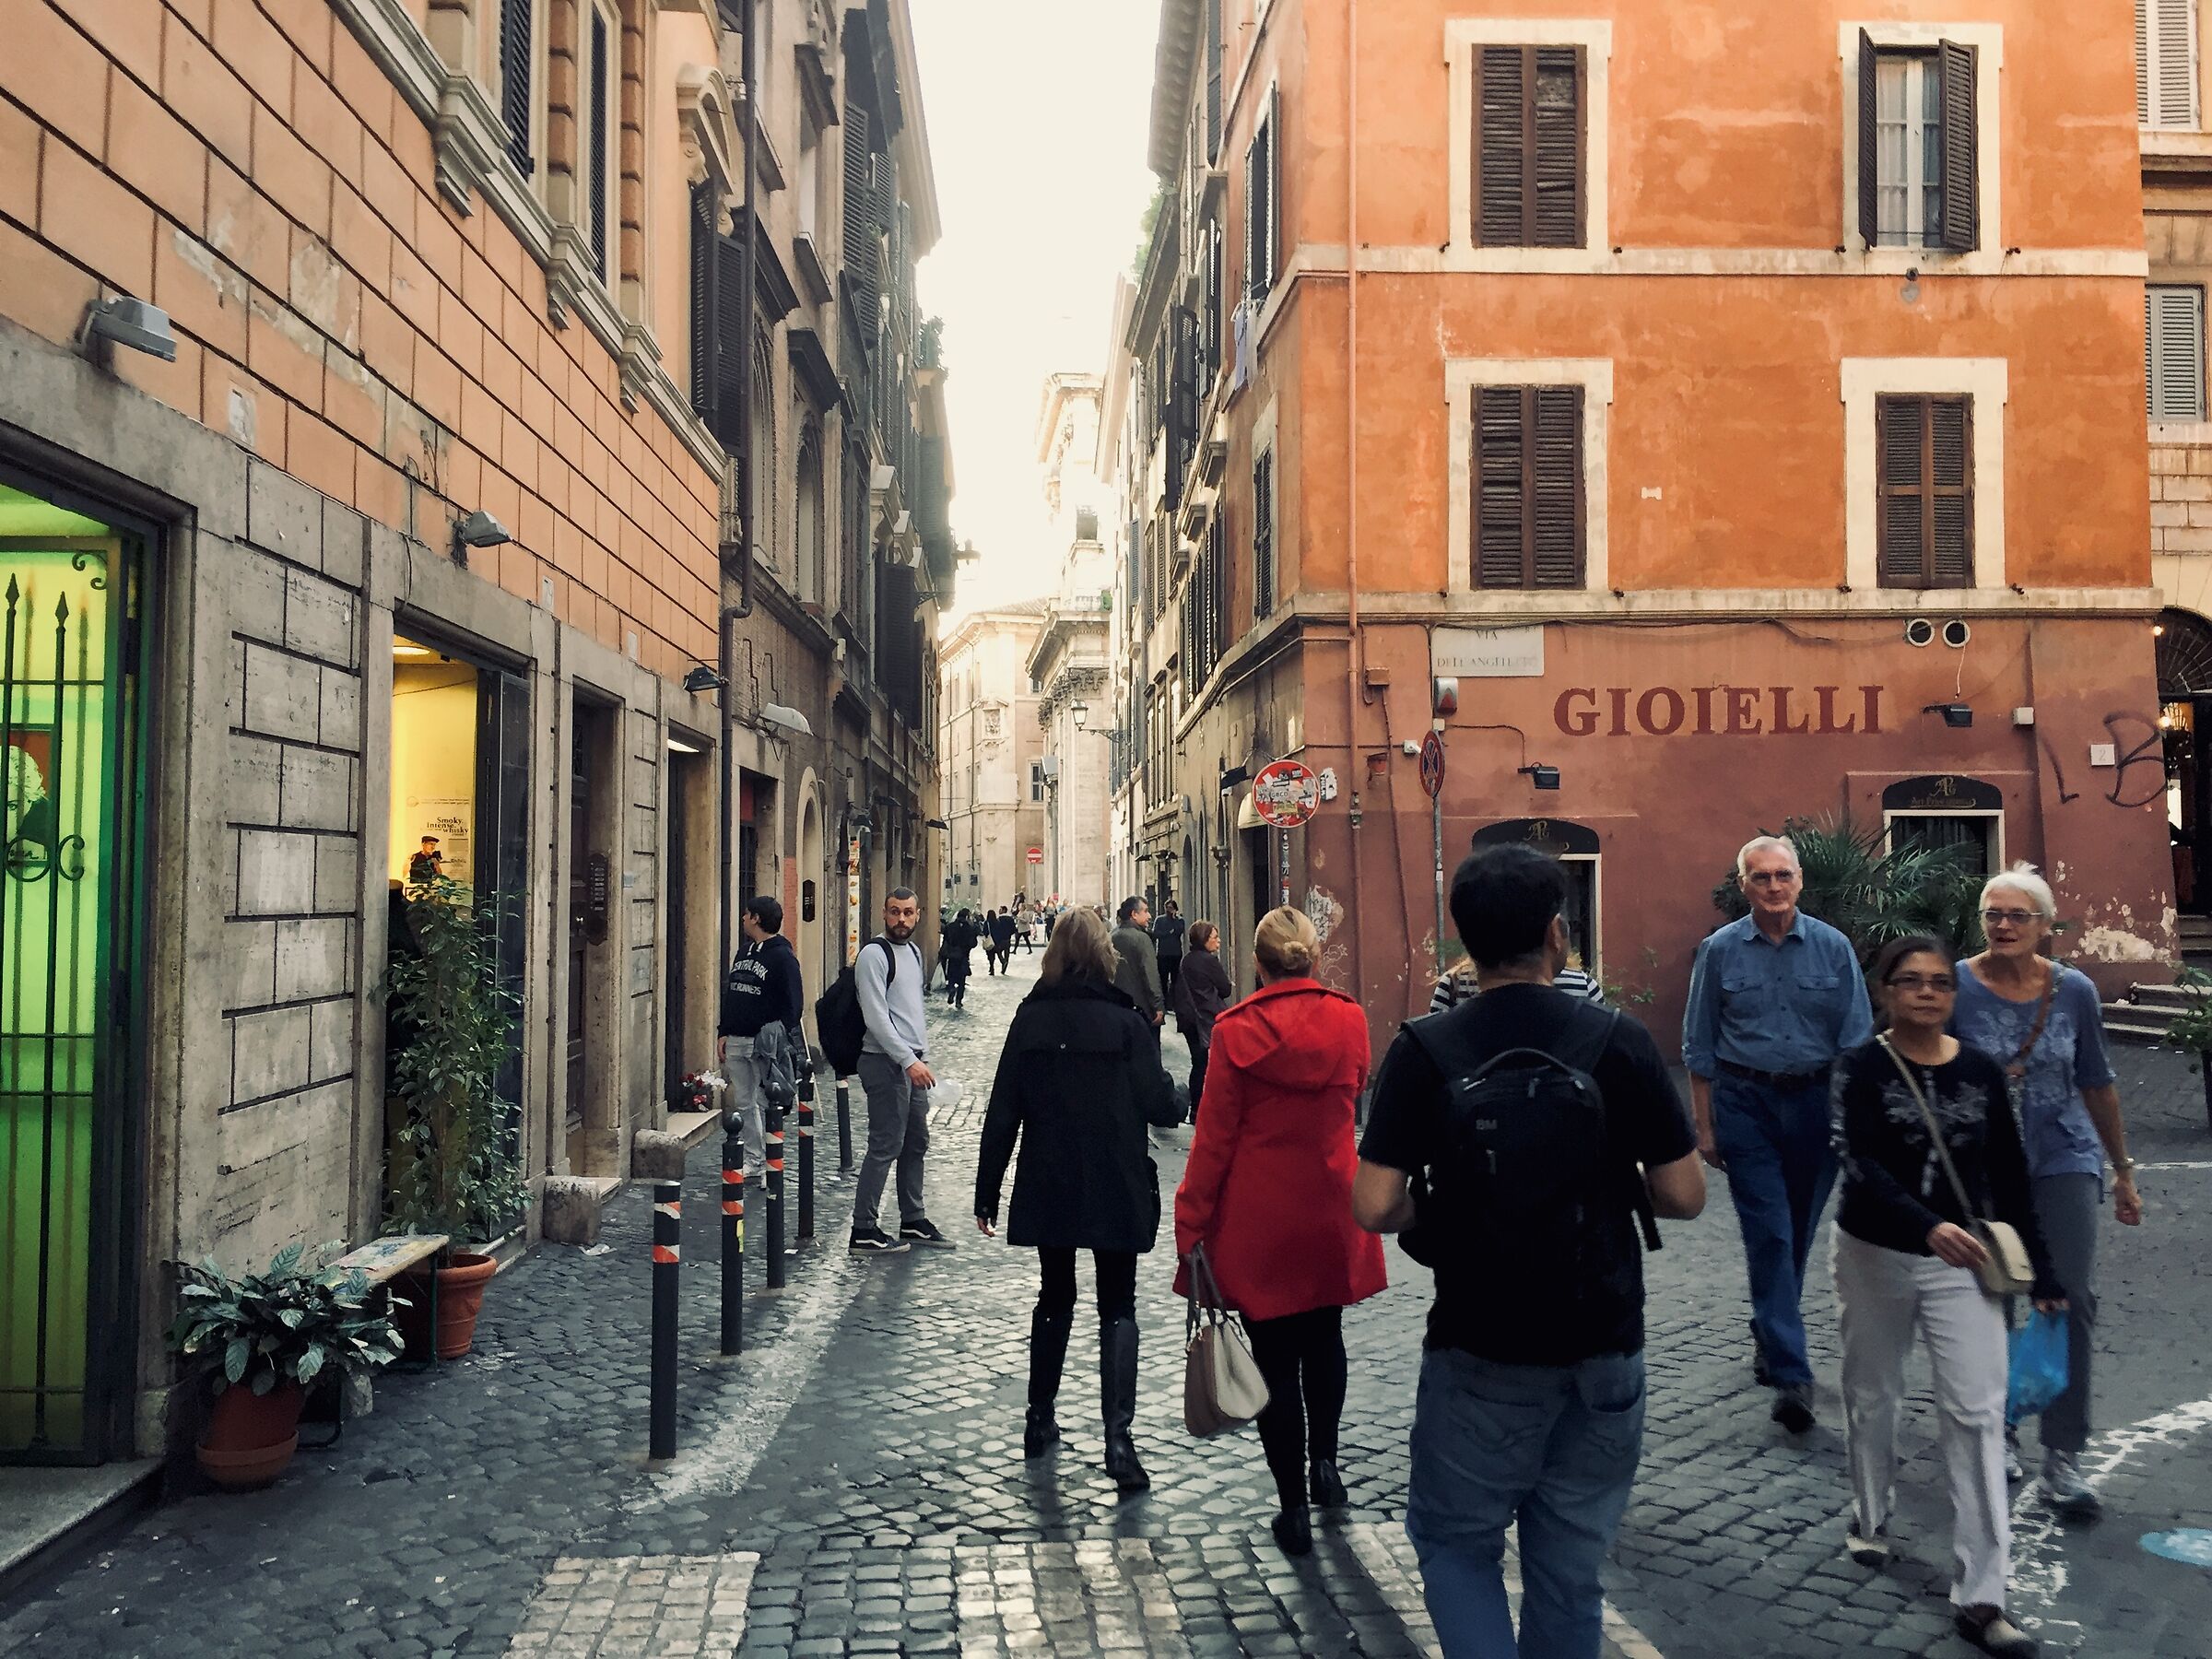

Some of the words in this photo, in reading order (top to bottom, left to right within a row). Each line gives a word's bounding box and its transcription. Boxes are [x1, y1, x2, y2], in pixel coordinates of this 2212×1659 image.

[1475, 629, 1498, 640] VIA
[1554, 686, 1884, 735] GIOIELLI
[751, 960, 768, 981] PARK
